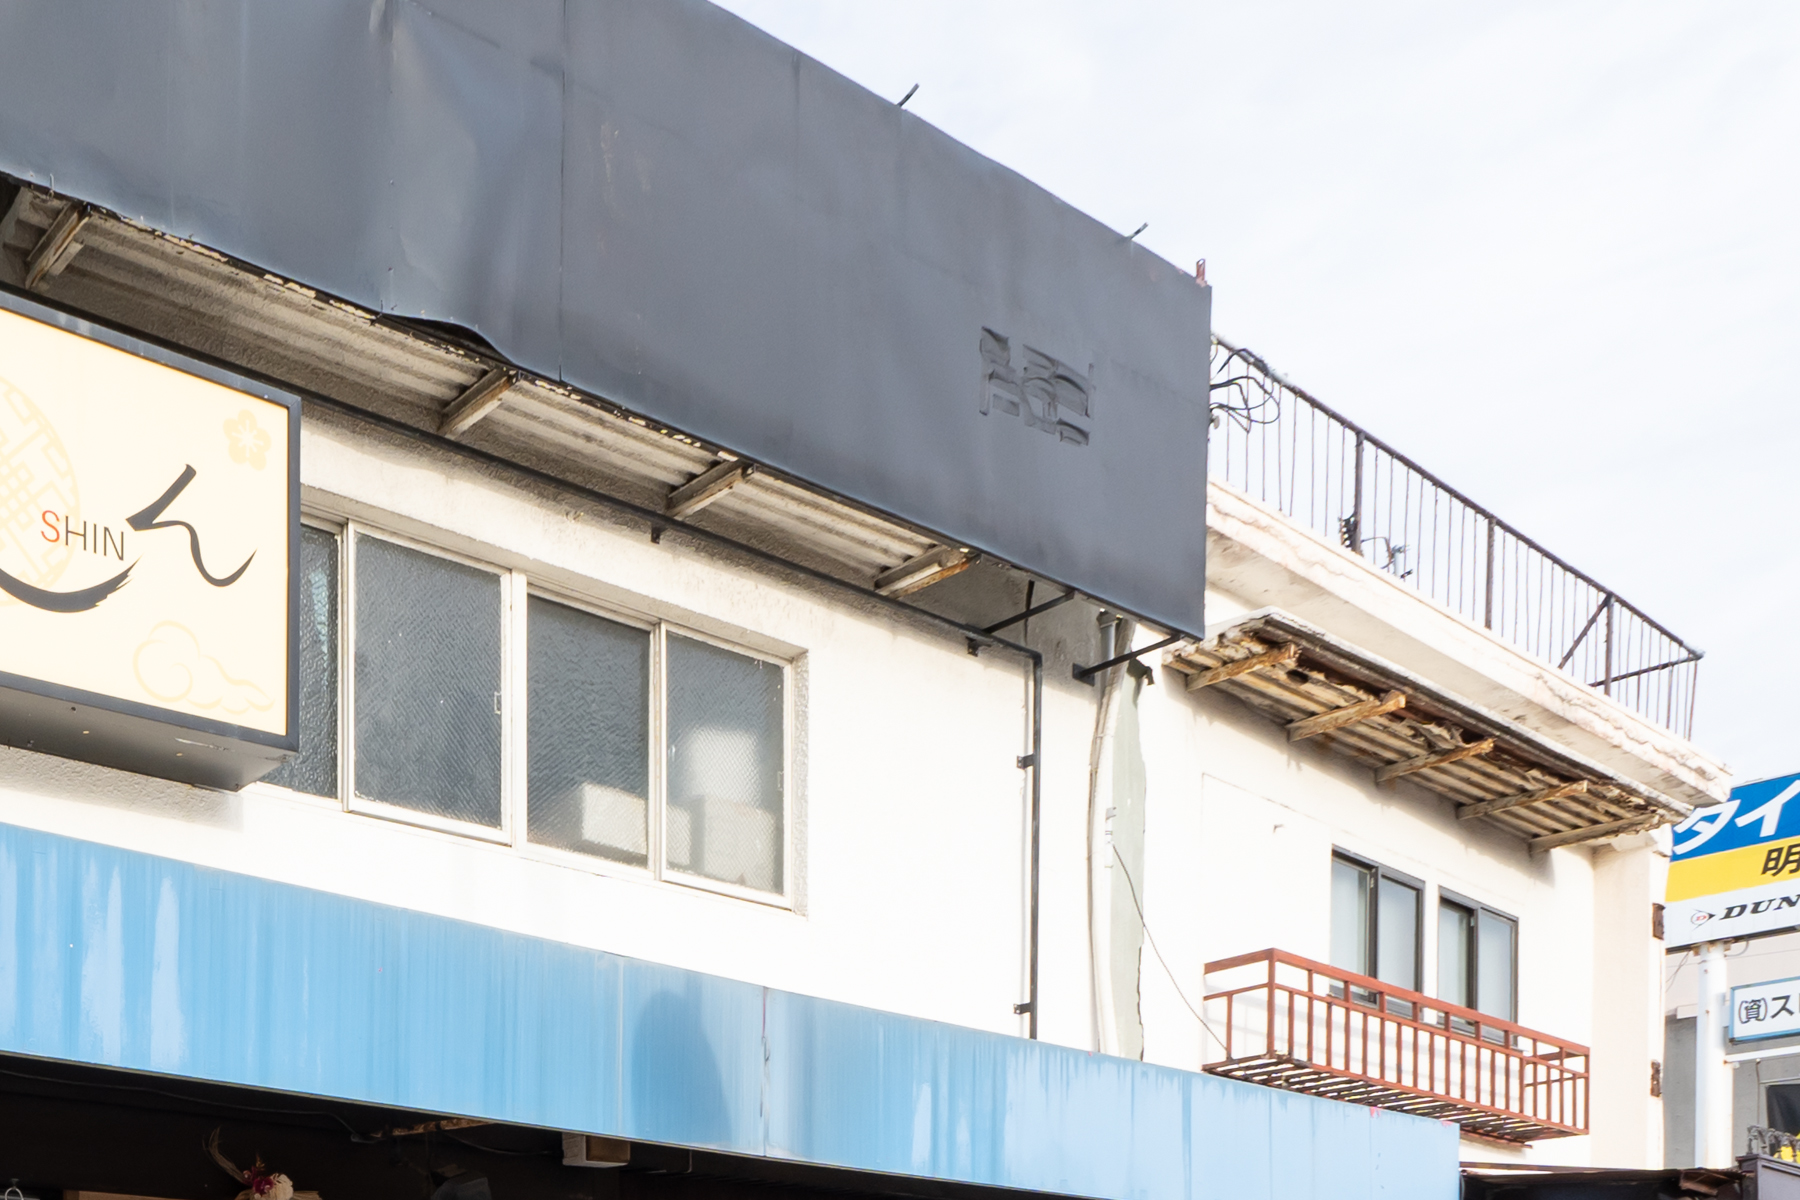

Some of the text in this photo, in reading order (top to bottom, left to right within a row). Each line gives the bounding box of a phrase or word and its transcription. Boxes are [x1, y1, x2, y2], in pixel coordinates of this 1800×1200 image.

[40, 510, 125, 562] SHIN
[1672, 778, 1800, 856] タイ
[1738, 993, 1800, 1024] (資)ス
